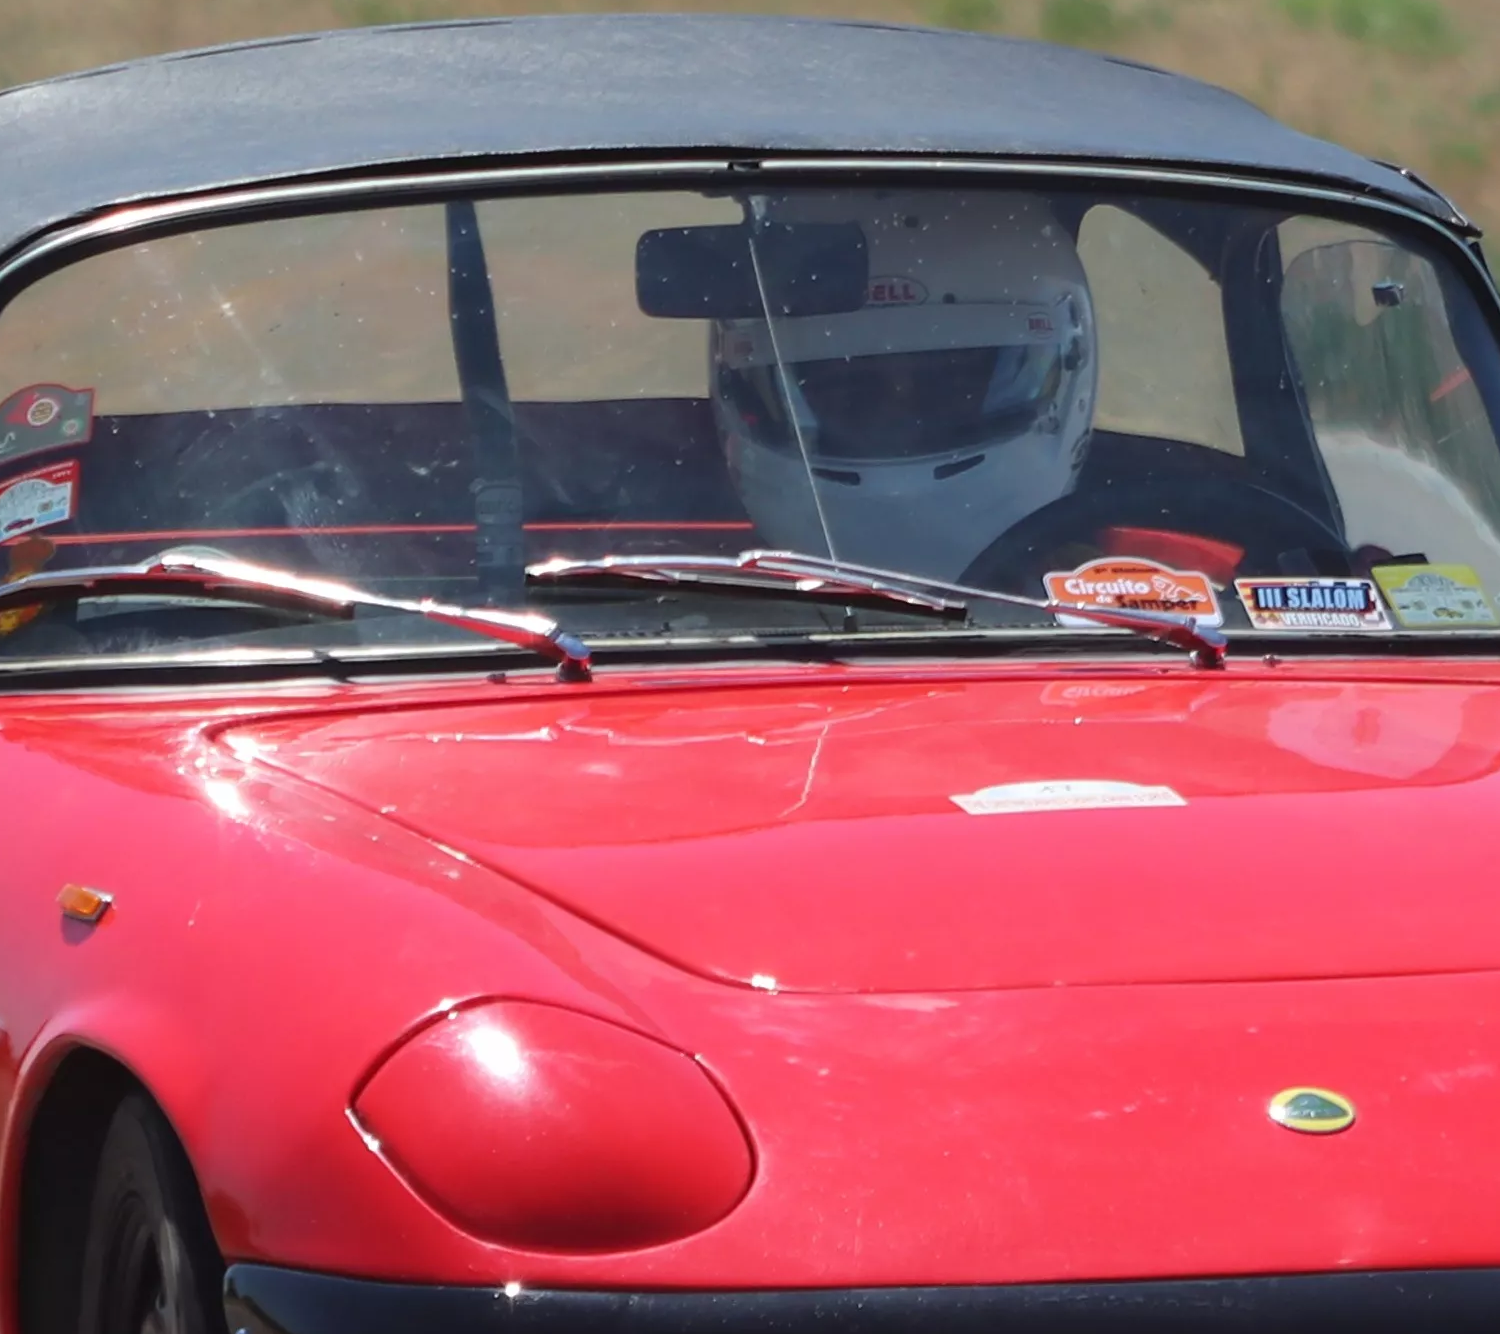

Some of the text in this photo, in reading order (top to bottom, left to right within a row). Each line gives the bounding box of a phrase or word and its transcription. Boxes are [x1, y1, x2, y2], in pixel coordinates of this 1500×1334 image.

[866, 283, 917, 302] ELL
[1064, 578, 1150, 596] Circuito
[1095, 594, 1114, 604] de
[1115, 595, 1198, 612] Samper
[1257, 587, 1365, 609] III SLALOM
[1281, 612, 1360, 627] VERIFICADO
